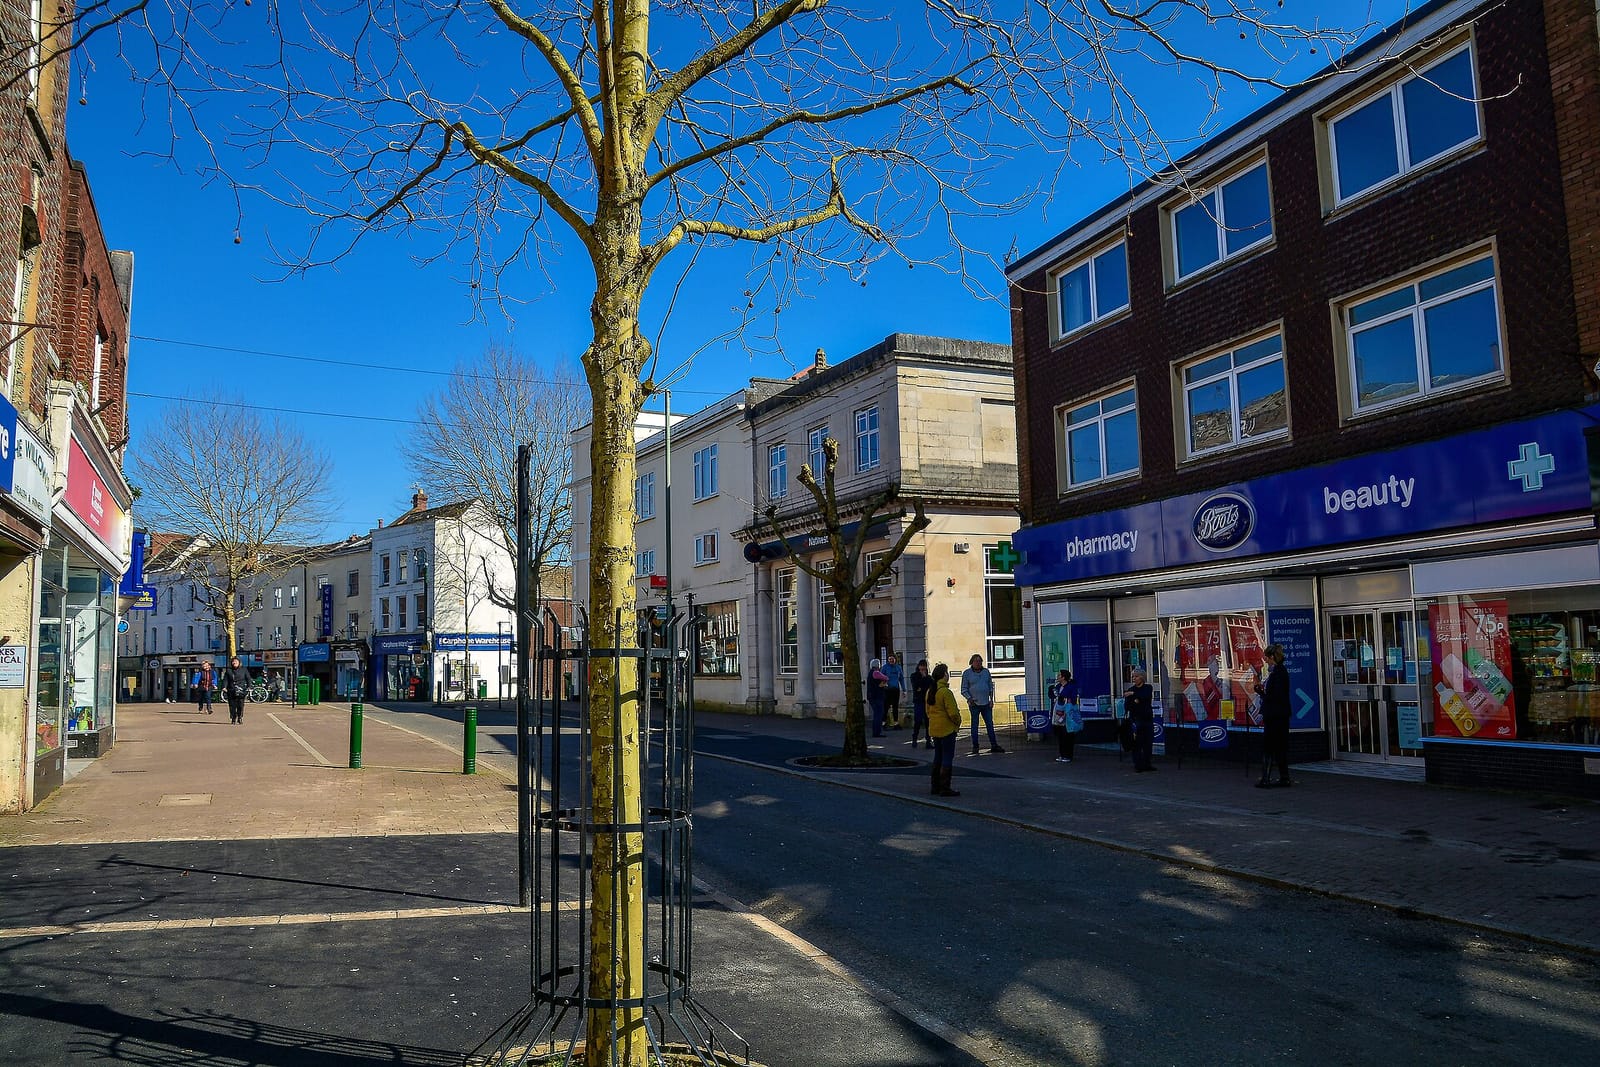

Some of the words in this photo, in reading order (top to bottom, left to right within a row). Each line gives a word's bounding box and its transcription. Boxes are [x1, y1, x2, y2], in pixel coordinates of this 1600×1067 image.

[1324, 474, 1415, 514] beauty
[1198, 504, 1239, 539] Boots
[1066, 530, 1138, 562] pharmacy
[1272, 616, 1311, 625] welcome
[1206, 630, 1221, 645] 75
